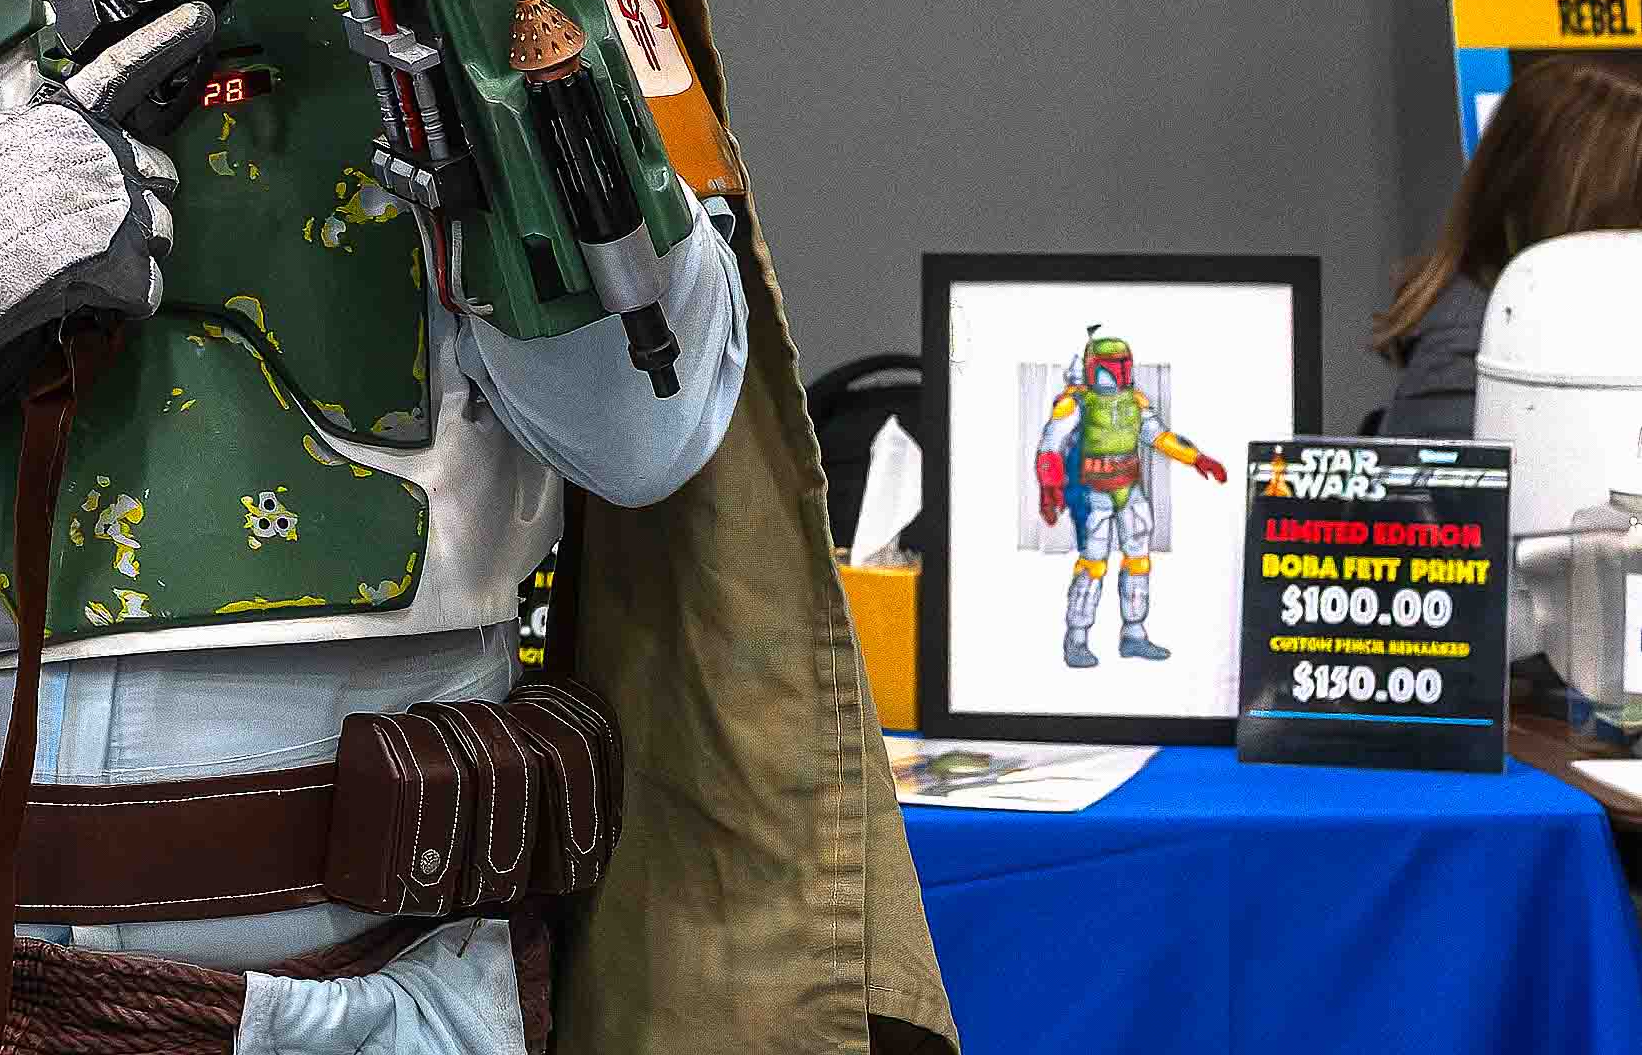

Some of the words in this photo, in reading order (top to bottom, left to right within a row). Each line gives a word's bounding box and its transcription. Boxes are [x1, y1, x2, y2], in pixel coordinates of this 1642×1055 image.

[205, 79, 243, 106] 28
[1301, 448, 1378, 474] STAR
[1292, 473, 1387, 500] WARS
[1265, 519, 1367, 544] LIMITED
[1373, 522, 1481, 548] EDITION
[1262, 554, 1339, 579] BOBA
[1343, 557, 1401, 581] FETT
[1411, 559, 1490, 584] PRINT
[1281, 584, 1453, 628] $100.00
[1292, 661, 1442, 704] $150.00
